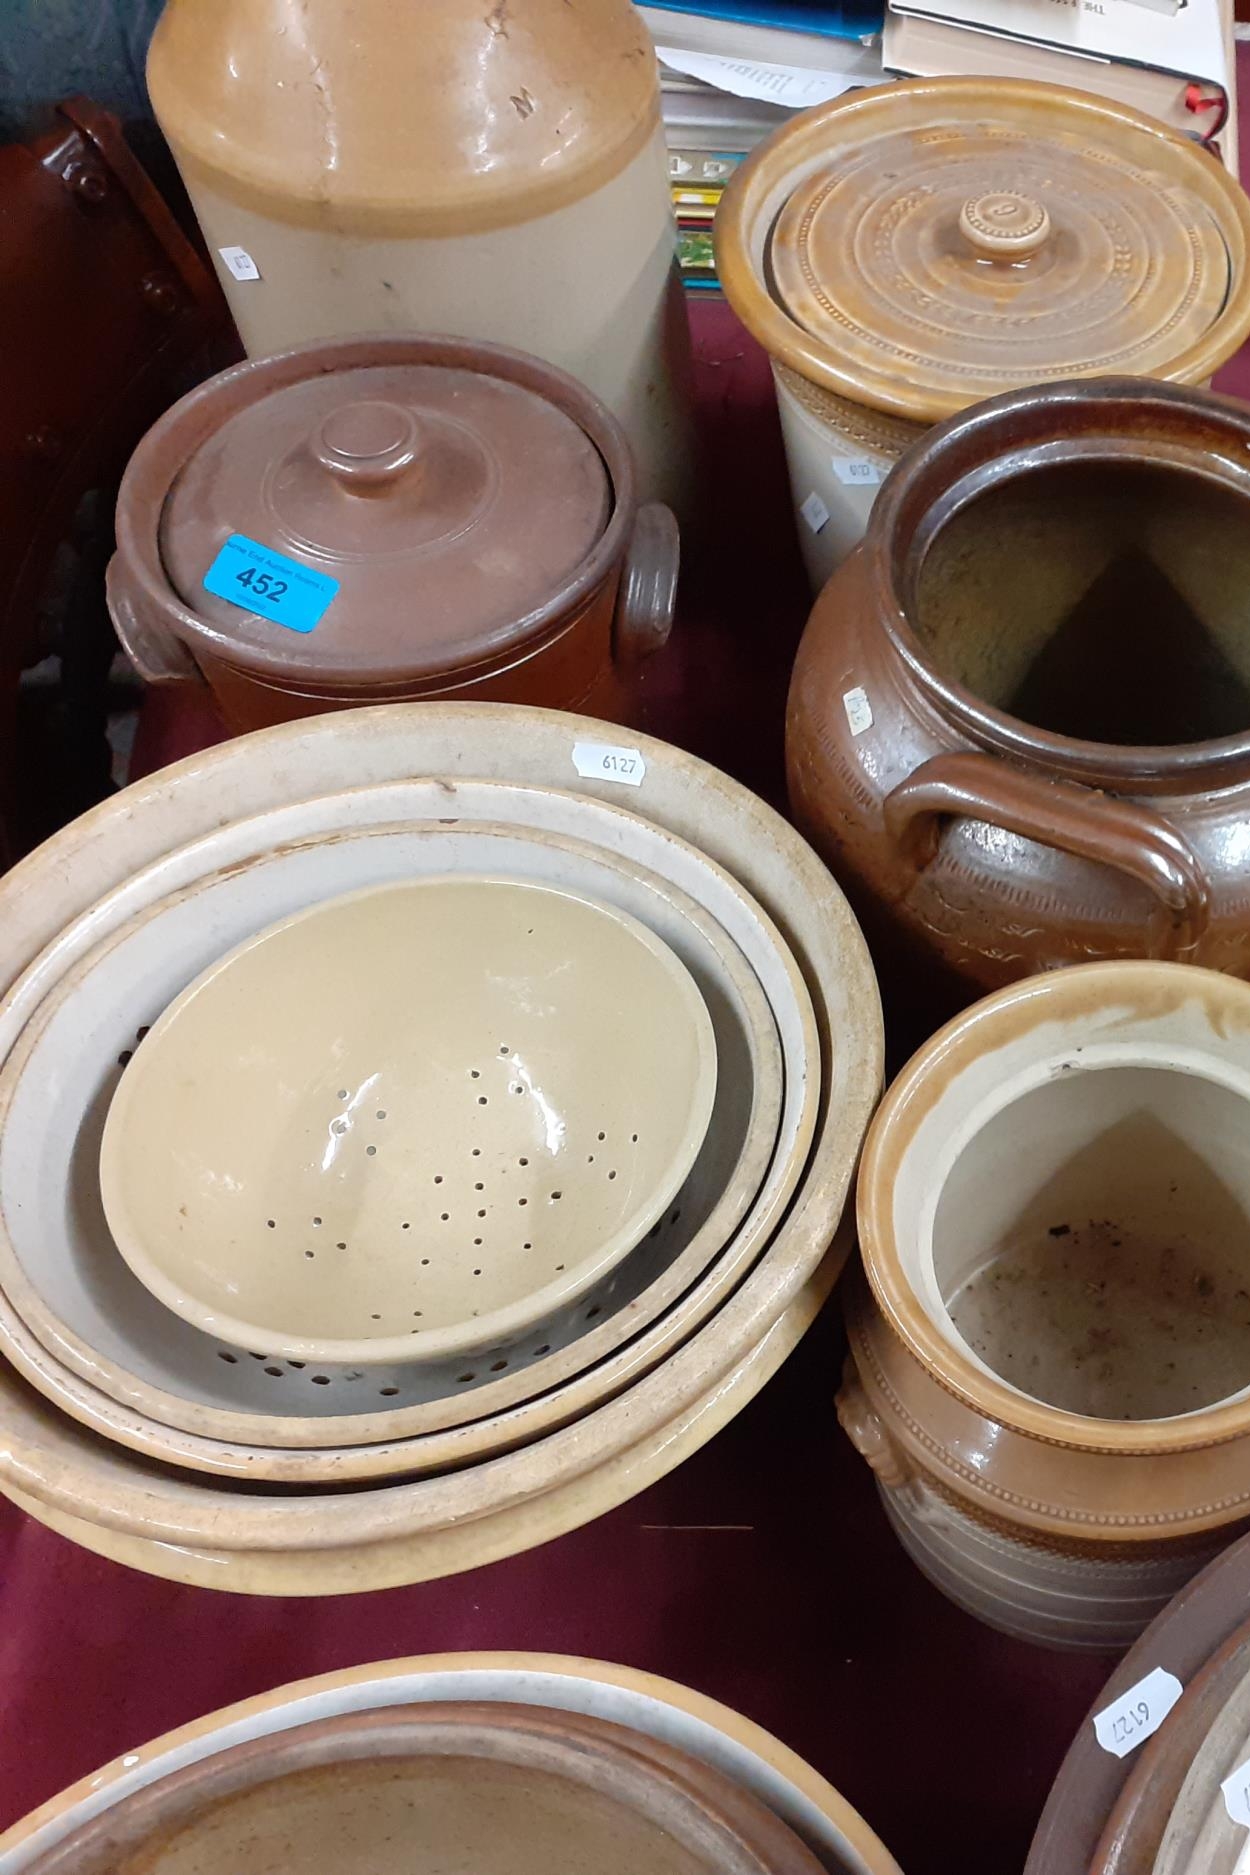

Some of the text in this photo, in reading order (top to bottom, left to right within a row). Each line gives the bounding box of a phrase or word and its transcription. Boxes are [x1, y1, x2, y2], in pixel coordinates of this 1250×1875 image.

[235, 567, 289, 604] 452
[602, 755, 637, 774] 6127
[1112, 1701, 1150, 1744] 6127
